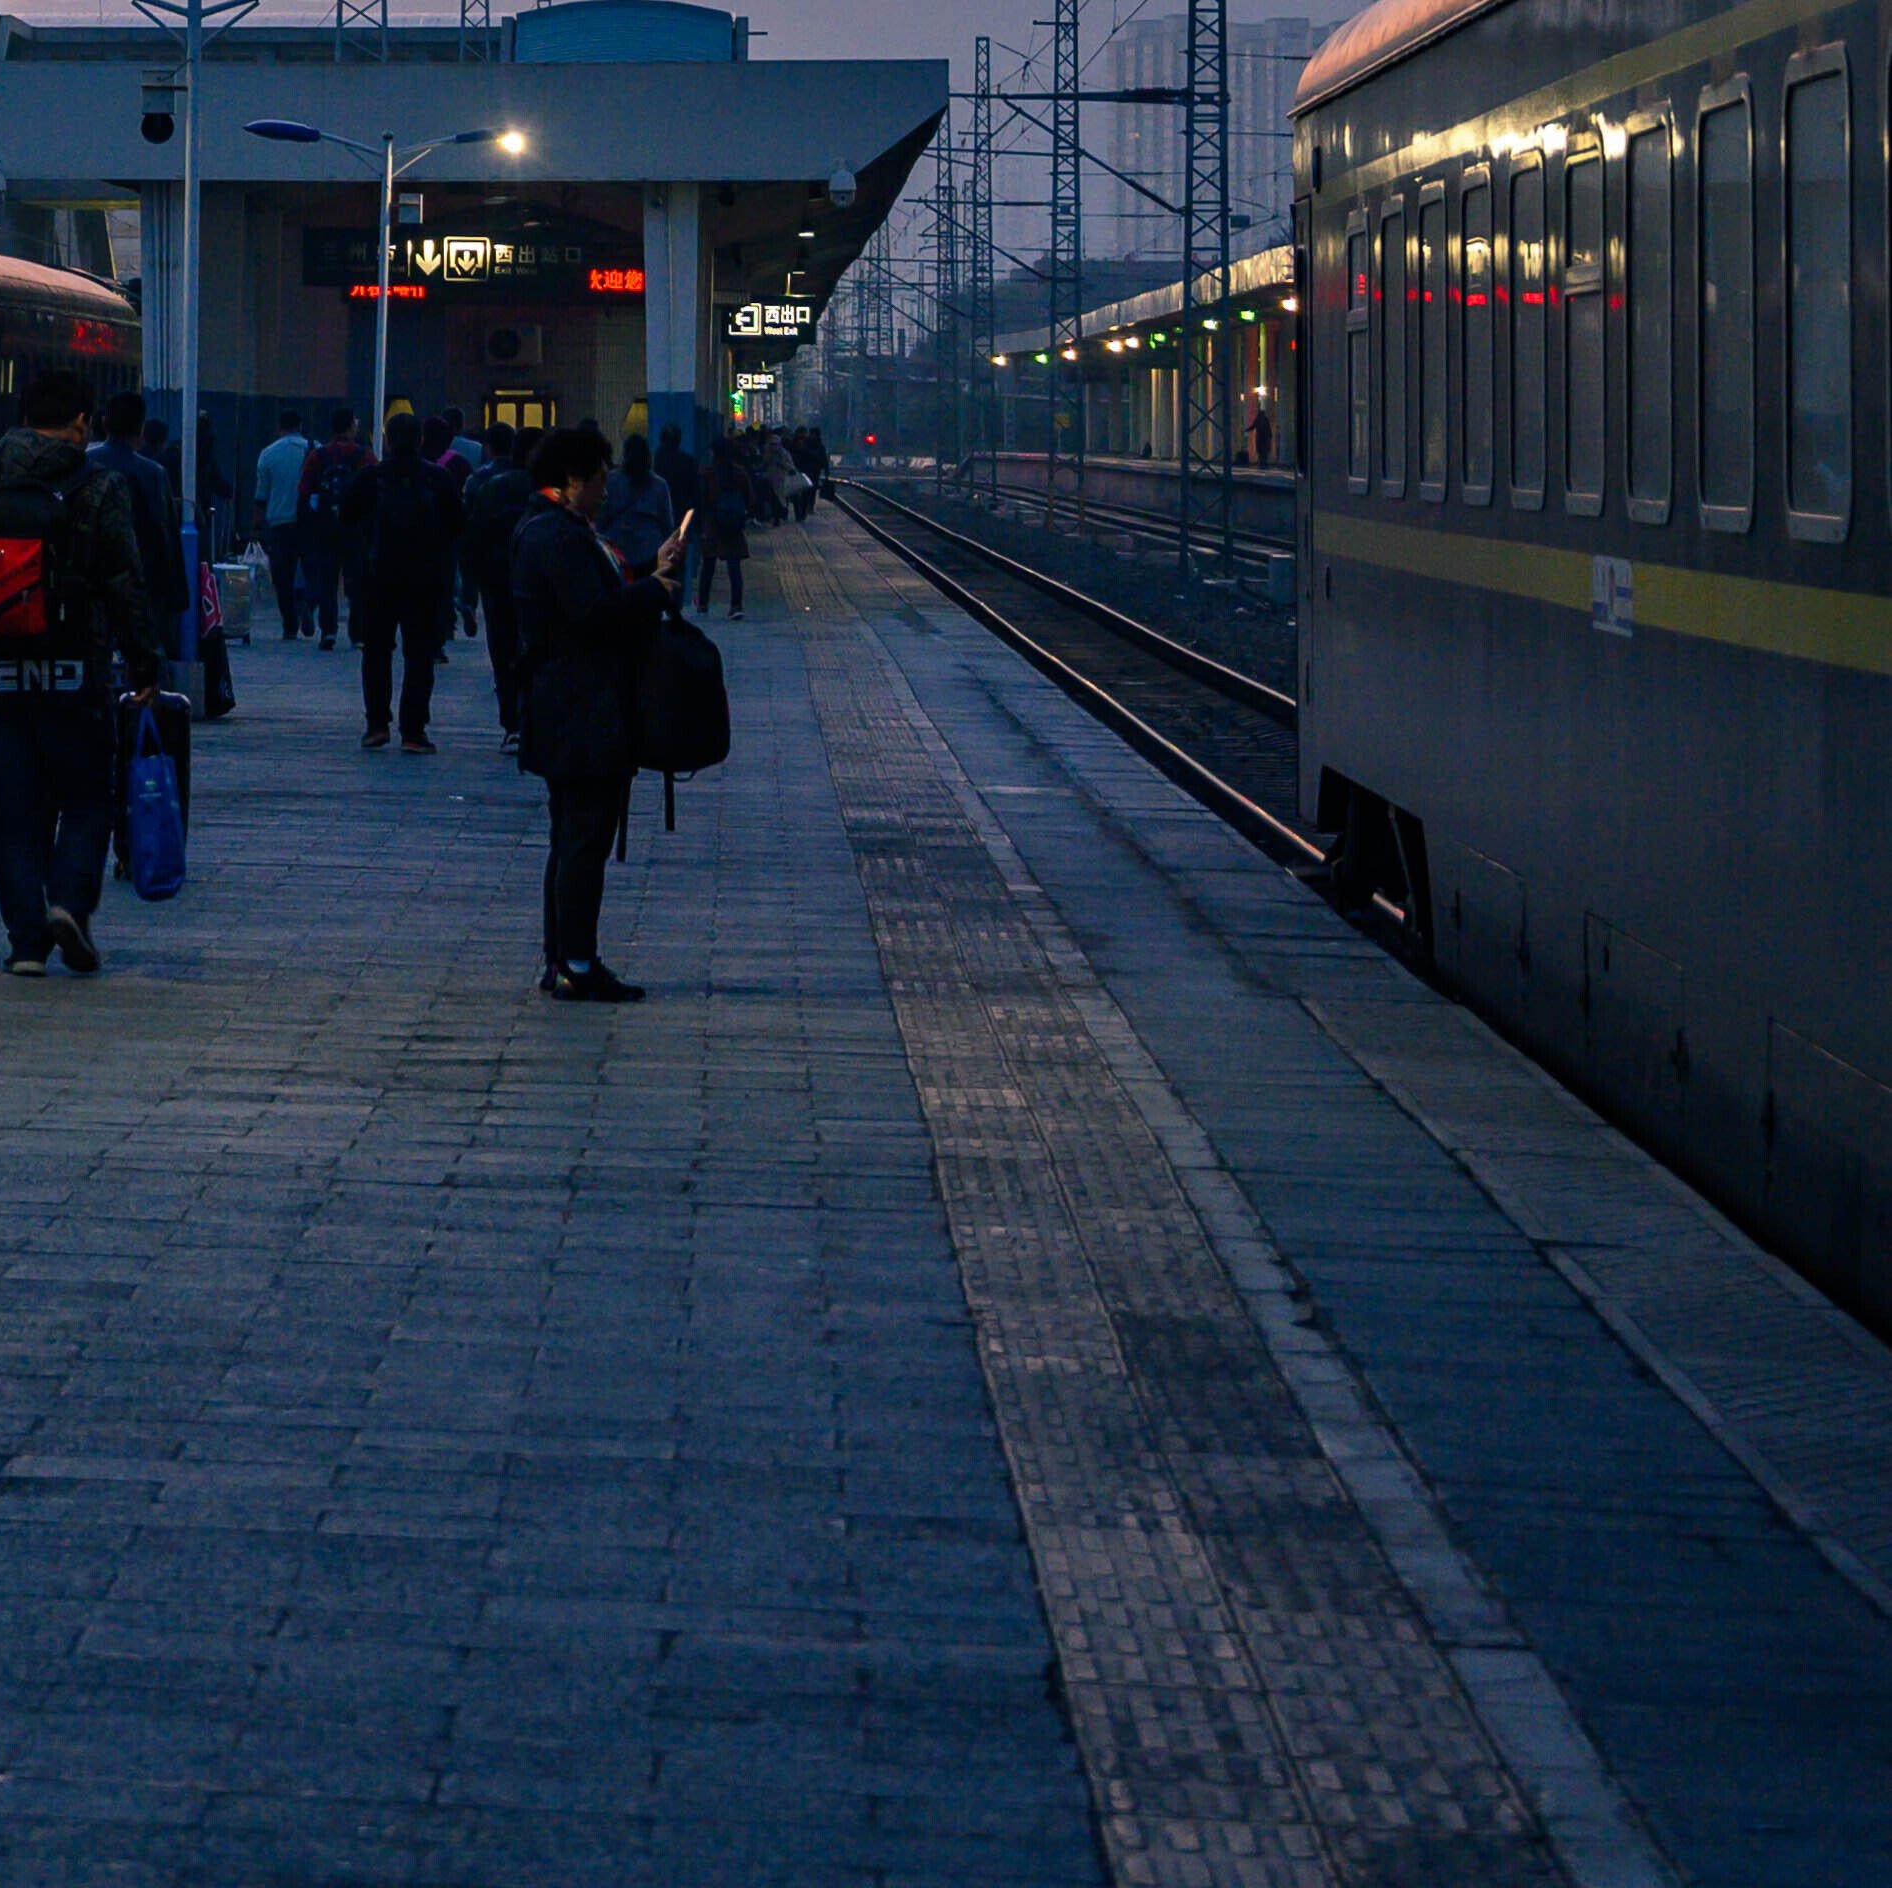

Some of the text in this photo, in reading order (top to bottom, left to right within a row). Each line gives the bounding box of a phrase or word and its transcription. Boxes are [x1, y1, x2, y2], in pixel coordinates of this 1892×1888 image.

[493, 243, 582, 264] 西出站口
[764, 305, 810, 324] 西出口
